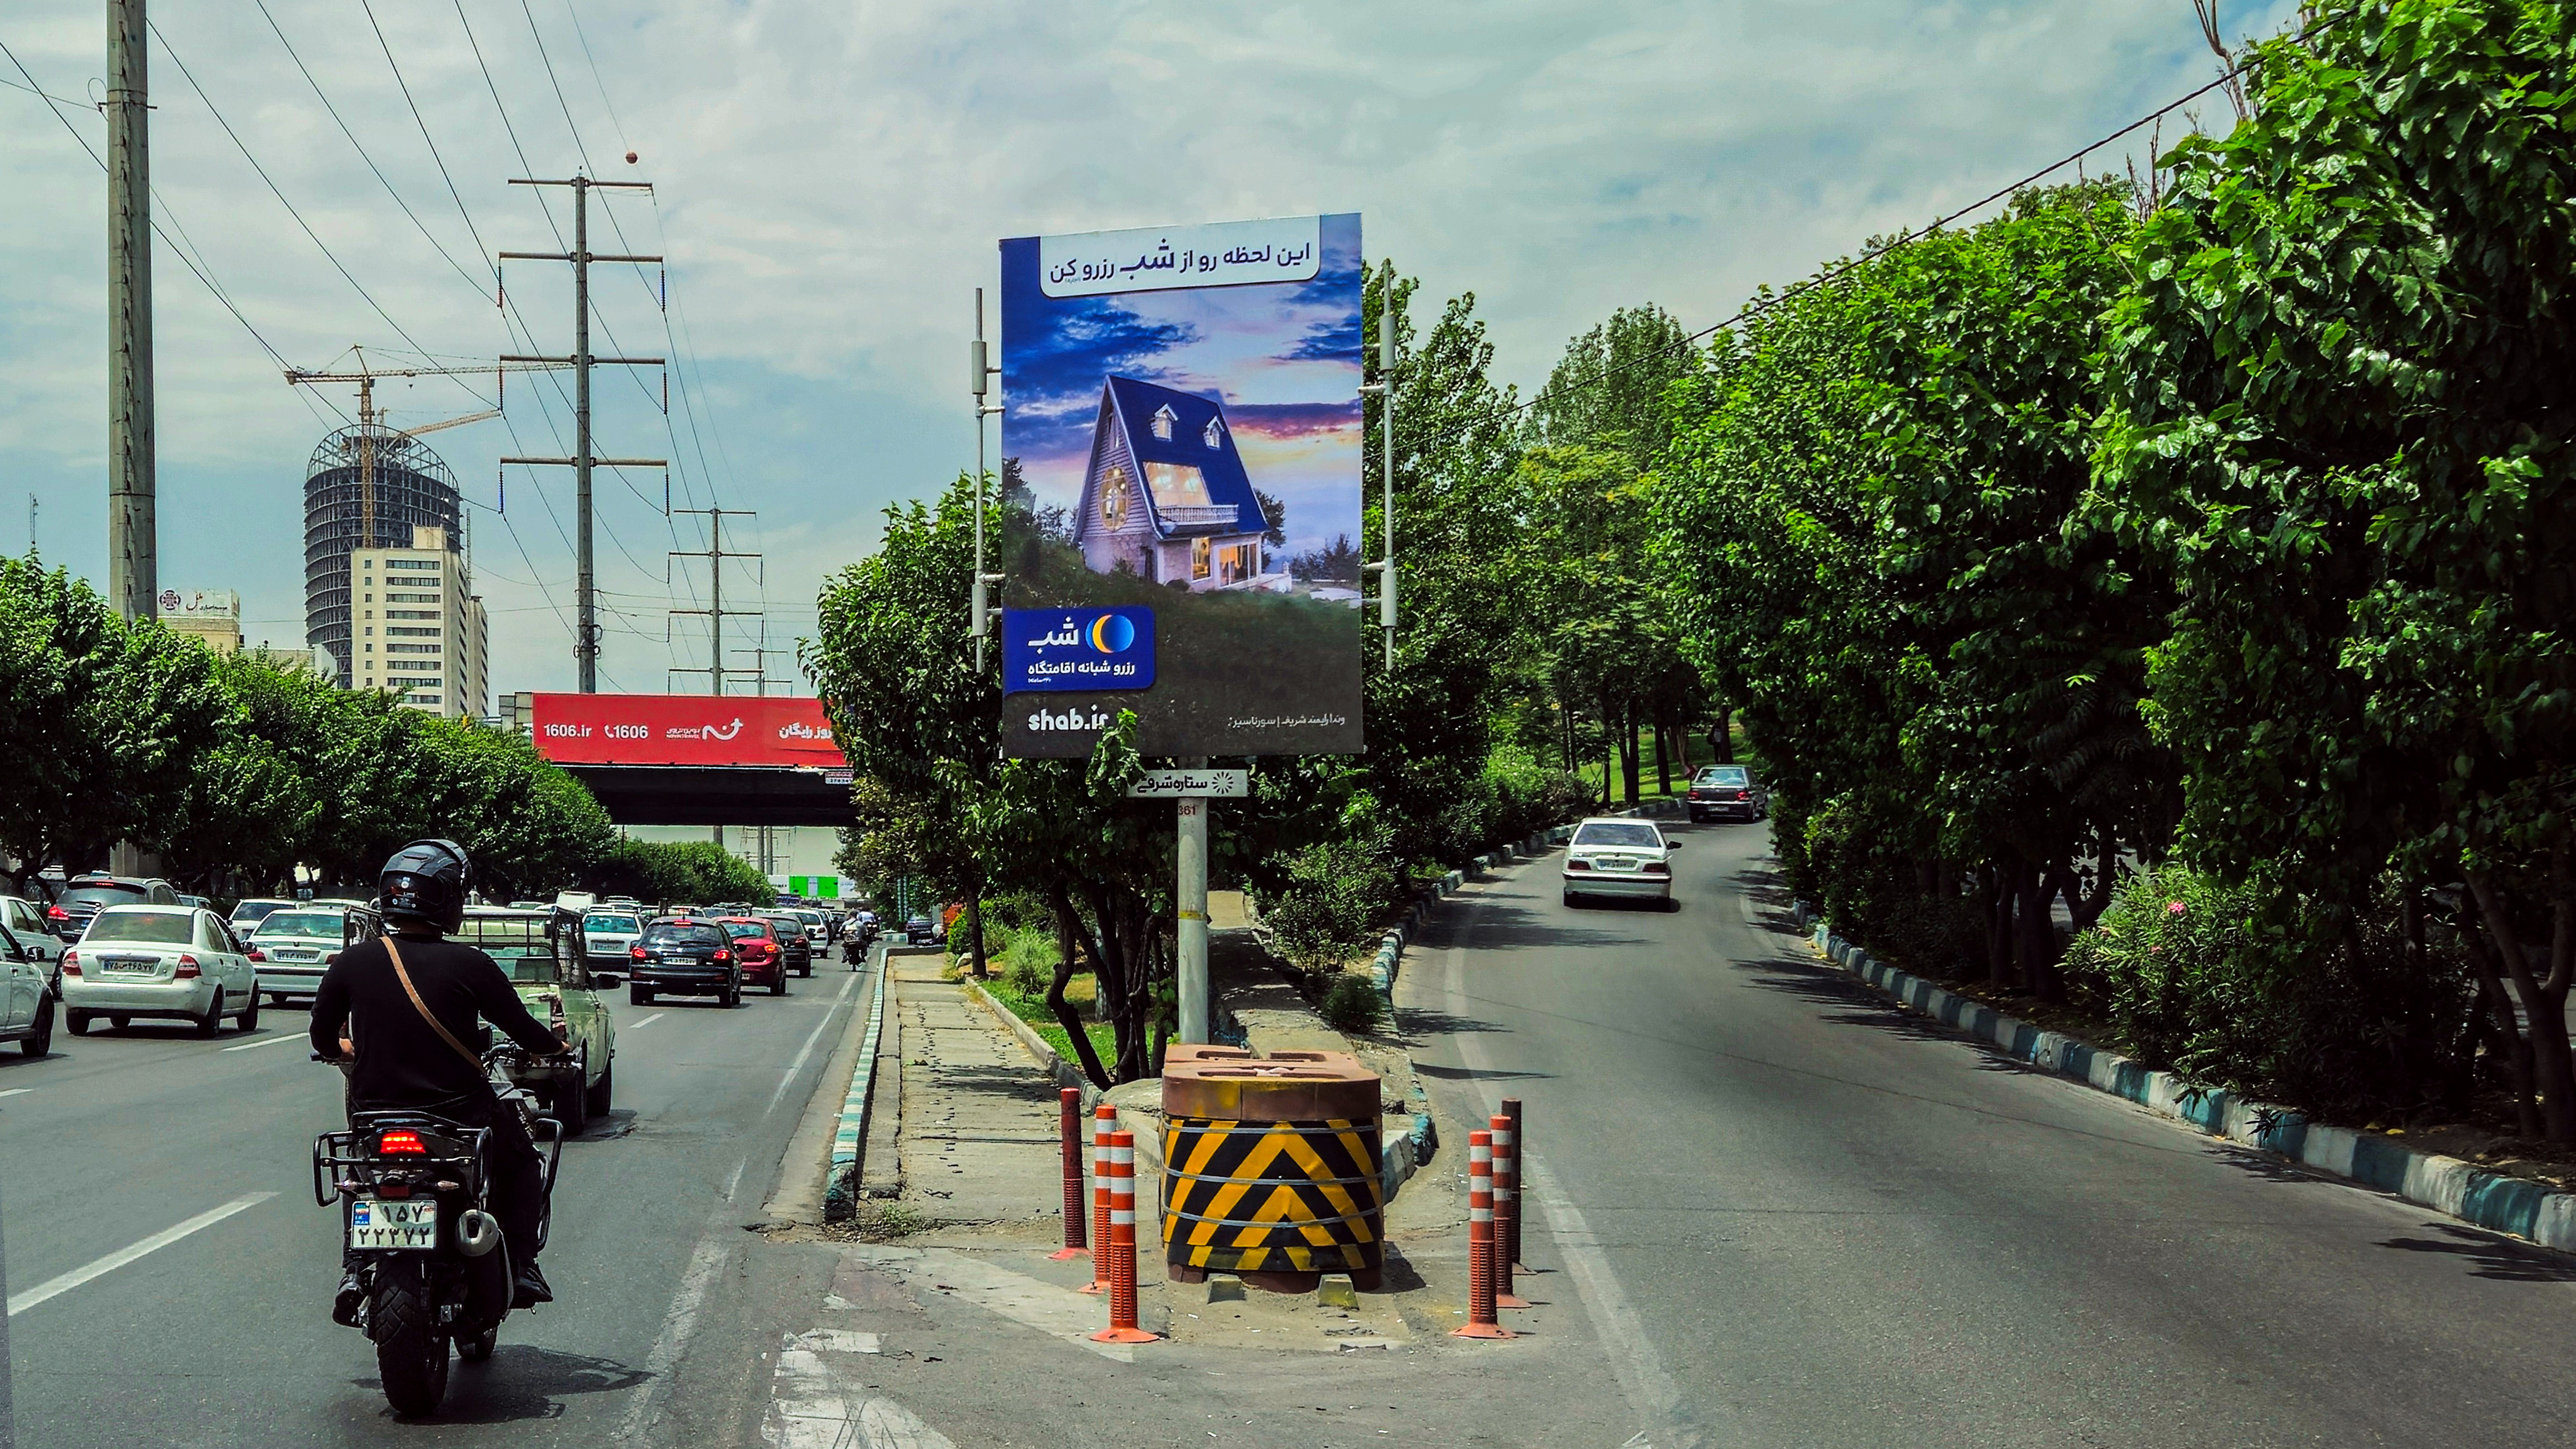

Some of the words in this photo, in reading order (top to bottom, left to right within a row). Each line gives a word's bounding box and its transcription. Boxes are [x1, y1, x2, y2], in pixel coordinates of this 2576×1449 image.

[1119, 238, 1175, 280] شب
[1179, 250, 1193, 273] از
[1223, 245, 1271, 264] لحظه
[1277, 242, 1310, 266] این
[1050, 259, 1076, 283] کن
[1083, 259, 1114, 281] رزرو
[1199, 255, 1217, 272] رو
[1027, 616, 1079, 654] شب
[1028, 660, 1075, 674] اقامتگاه
[1078, 660, 1111, 676] شبانه
[1113, 662, 1135, 676] رزرو
[1028, 704, 1109, 731] shab.ir
[1281, 715, 1307, 727] شریف
[543, 724, 592, 738] 1606.ir
[613, 725, 649, 739] 1606
[778, 722, 813, 739] رایگان
[1174, 775, 1208, 792] ستاره
[1178, 805, 1195, 815] 361
[384, 1205, 424, 1222] ۱۵۷
